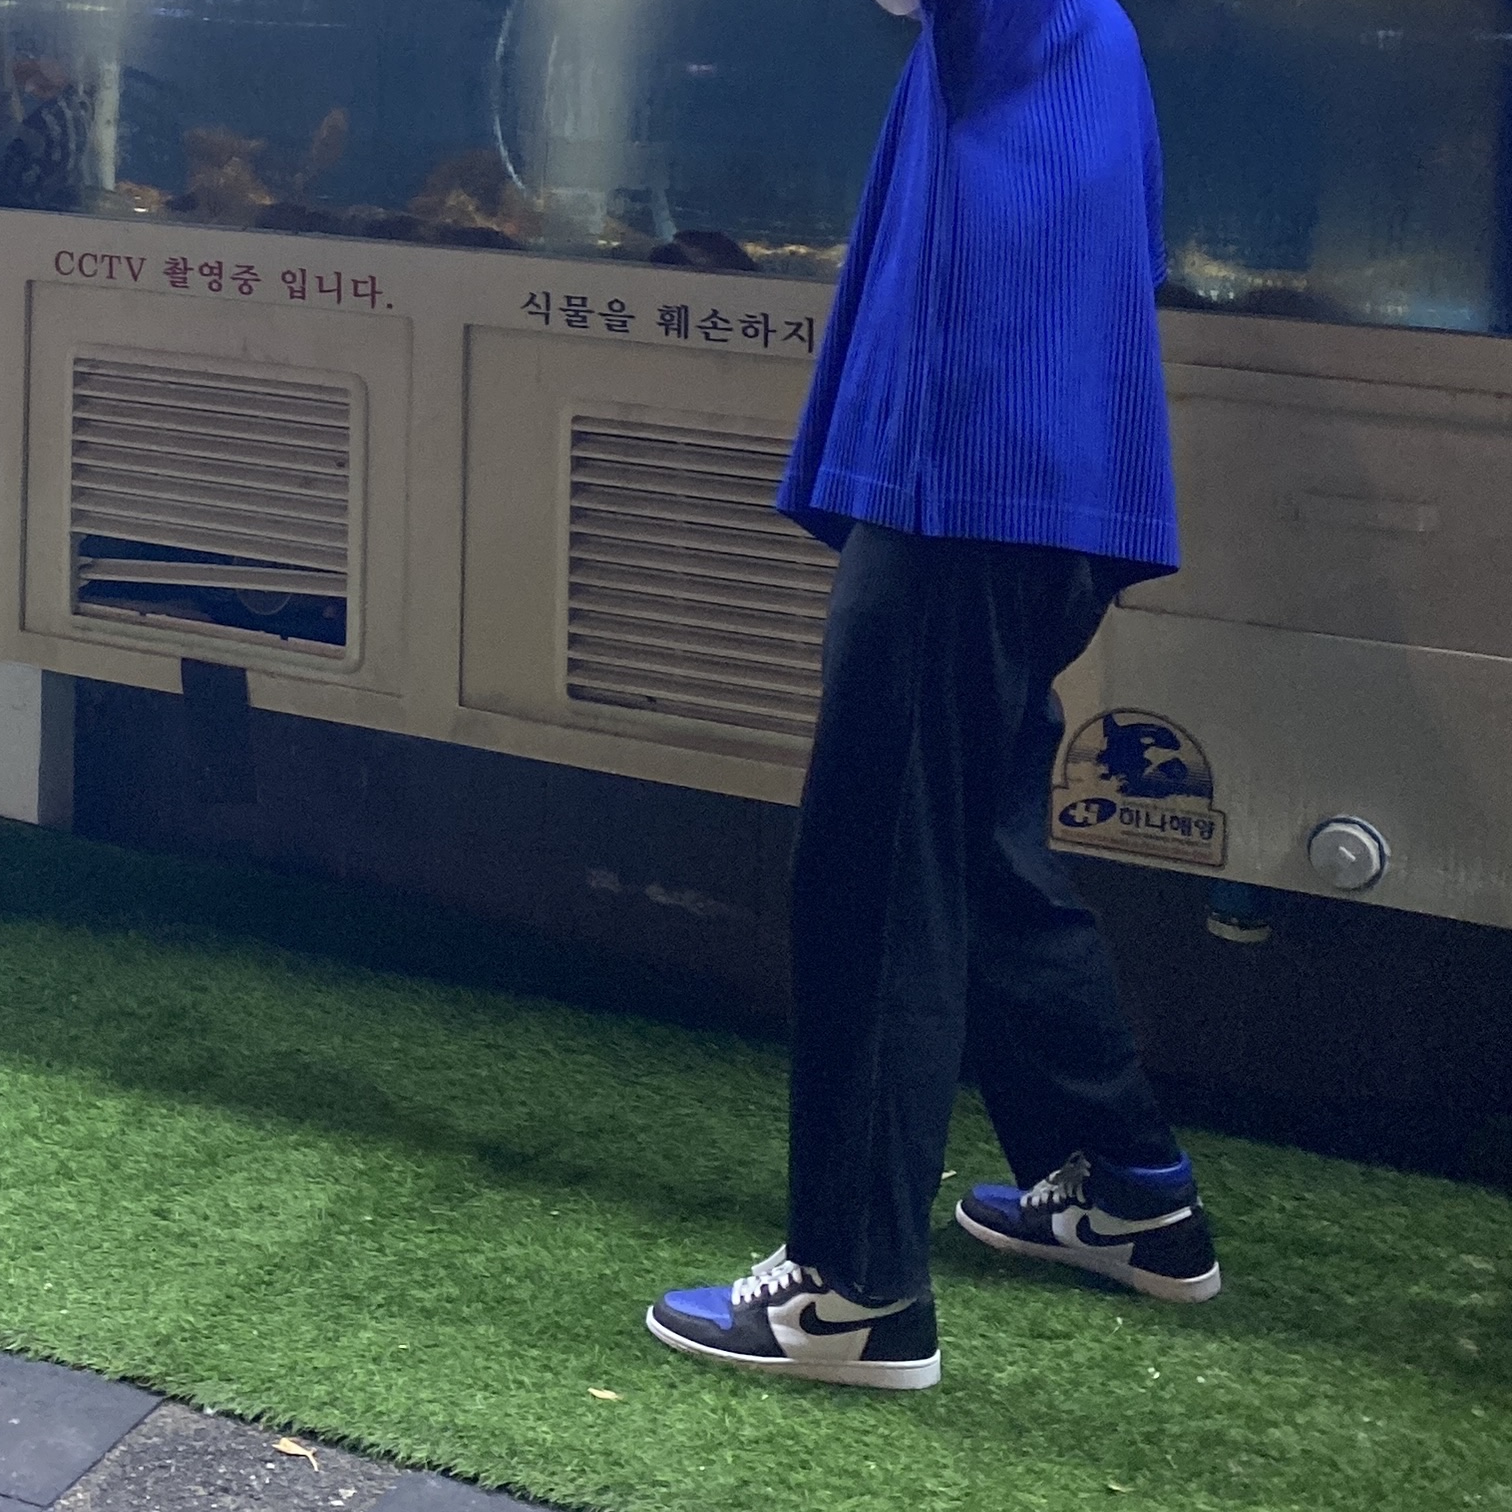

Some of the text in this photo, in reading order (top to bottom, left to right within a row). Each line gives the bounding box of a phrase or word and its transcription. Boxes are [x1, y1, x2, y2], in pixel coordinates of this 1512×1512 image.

[53, 250, 396, 312] CCTV 촬영중 입니다.
[520, 290, 816, 355] 식물을 훼손하지
